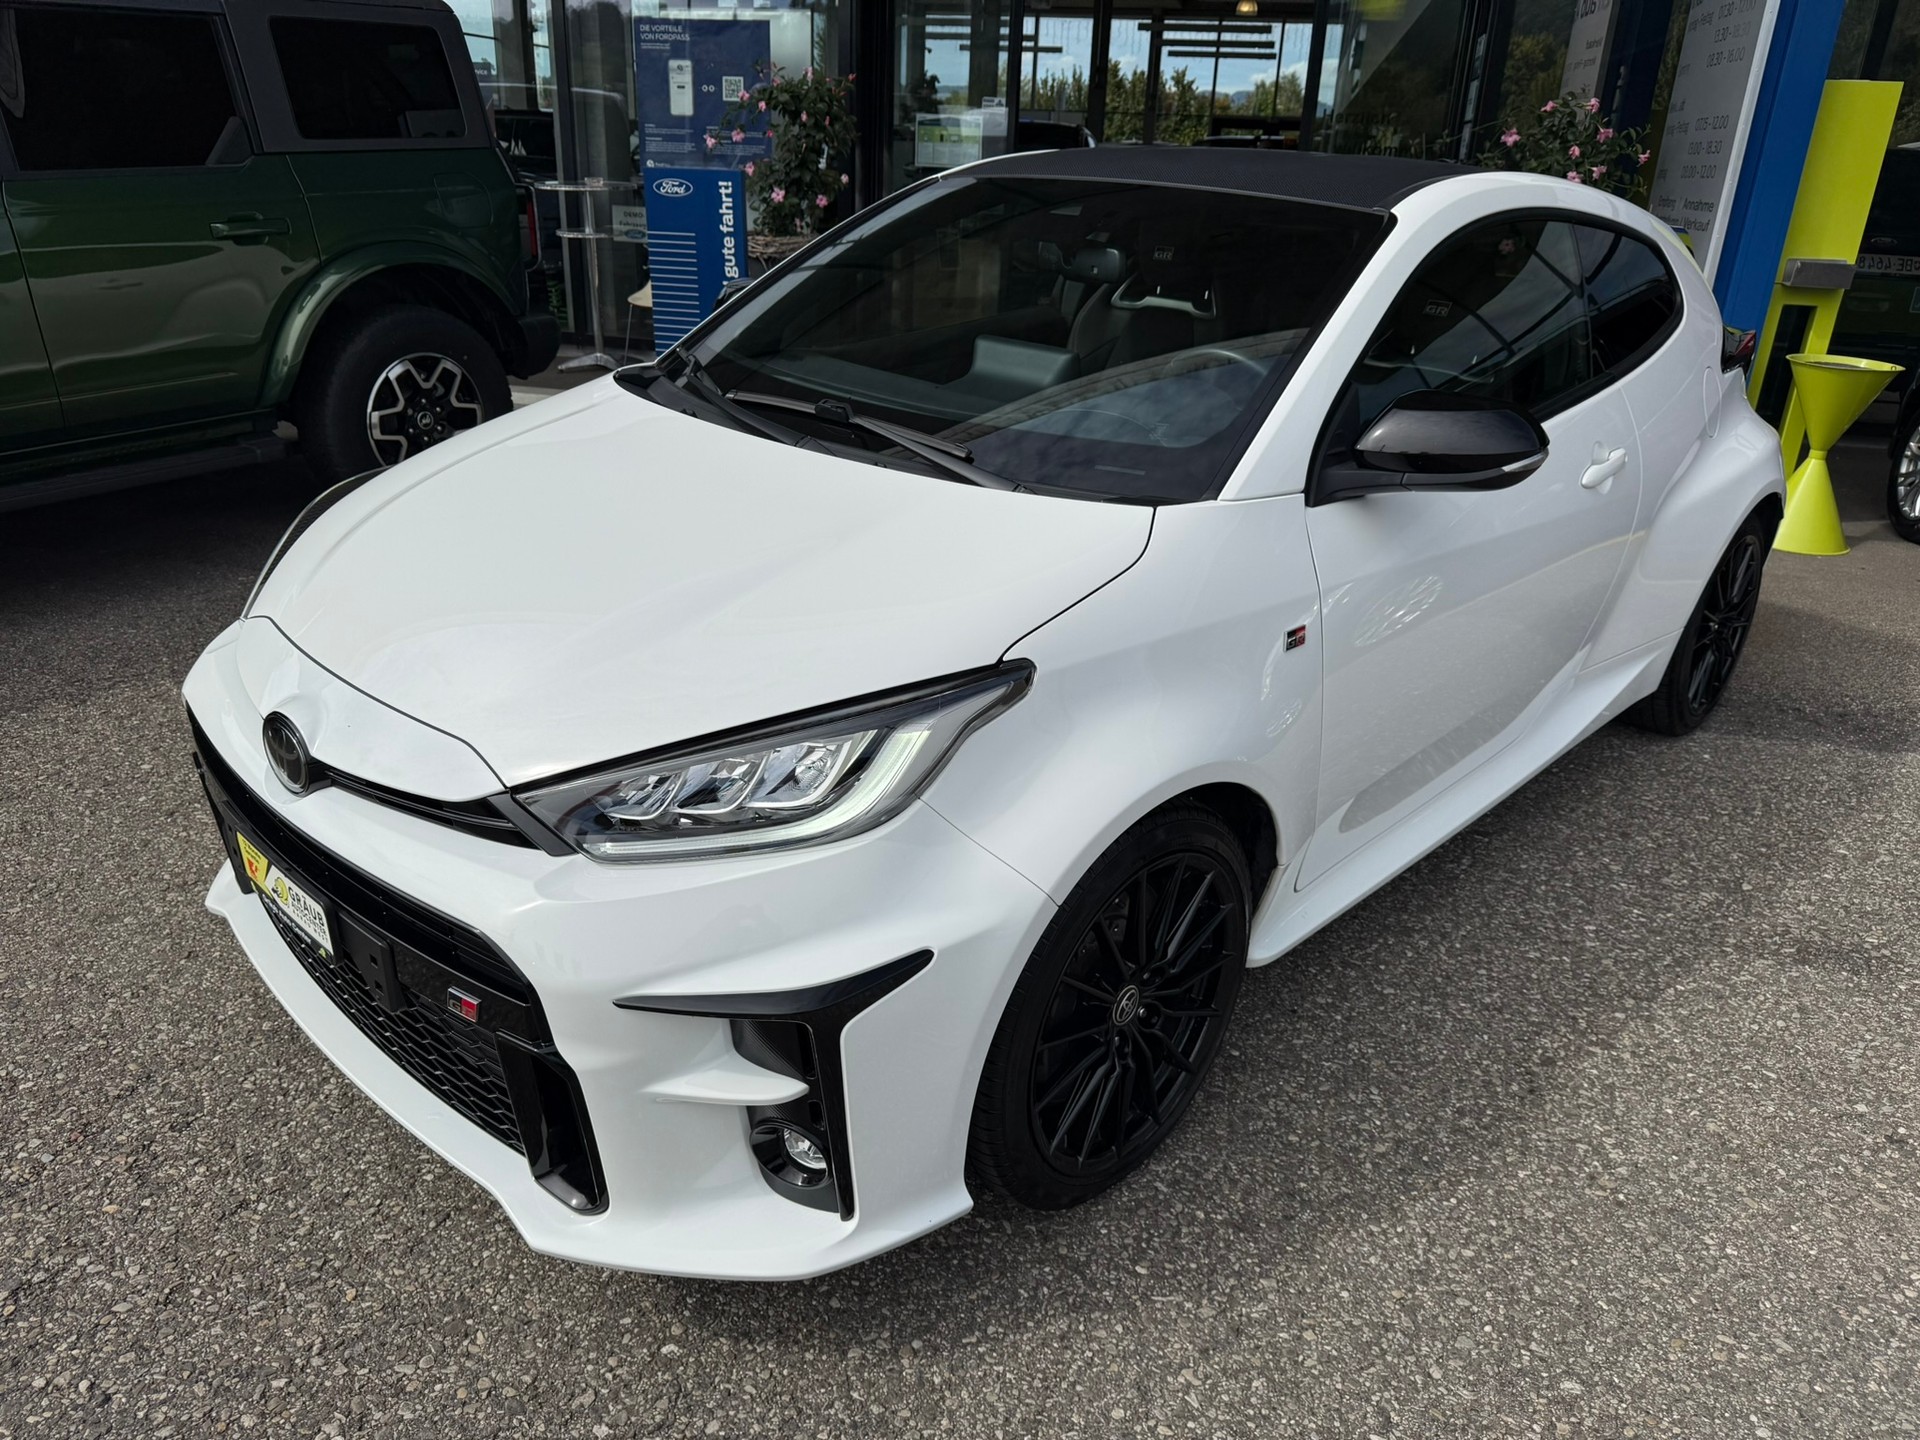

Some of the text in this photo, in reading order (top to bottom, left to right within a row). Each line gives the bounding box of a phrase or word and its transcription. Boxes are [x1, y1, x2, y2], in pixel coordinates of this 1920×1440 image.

[640, 24, 650, 32] DIE
[655, 33, 690, 41] FORDPASS
[659, 179, 687, 195] Ford
[718, 180, 735, 235] fahrt!
[722, 236, 739, 279] gute
[1425, 305, 1448, 317] GR
[449, 999, 476, 1021] GR
